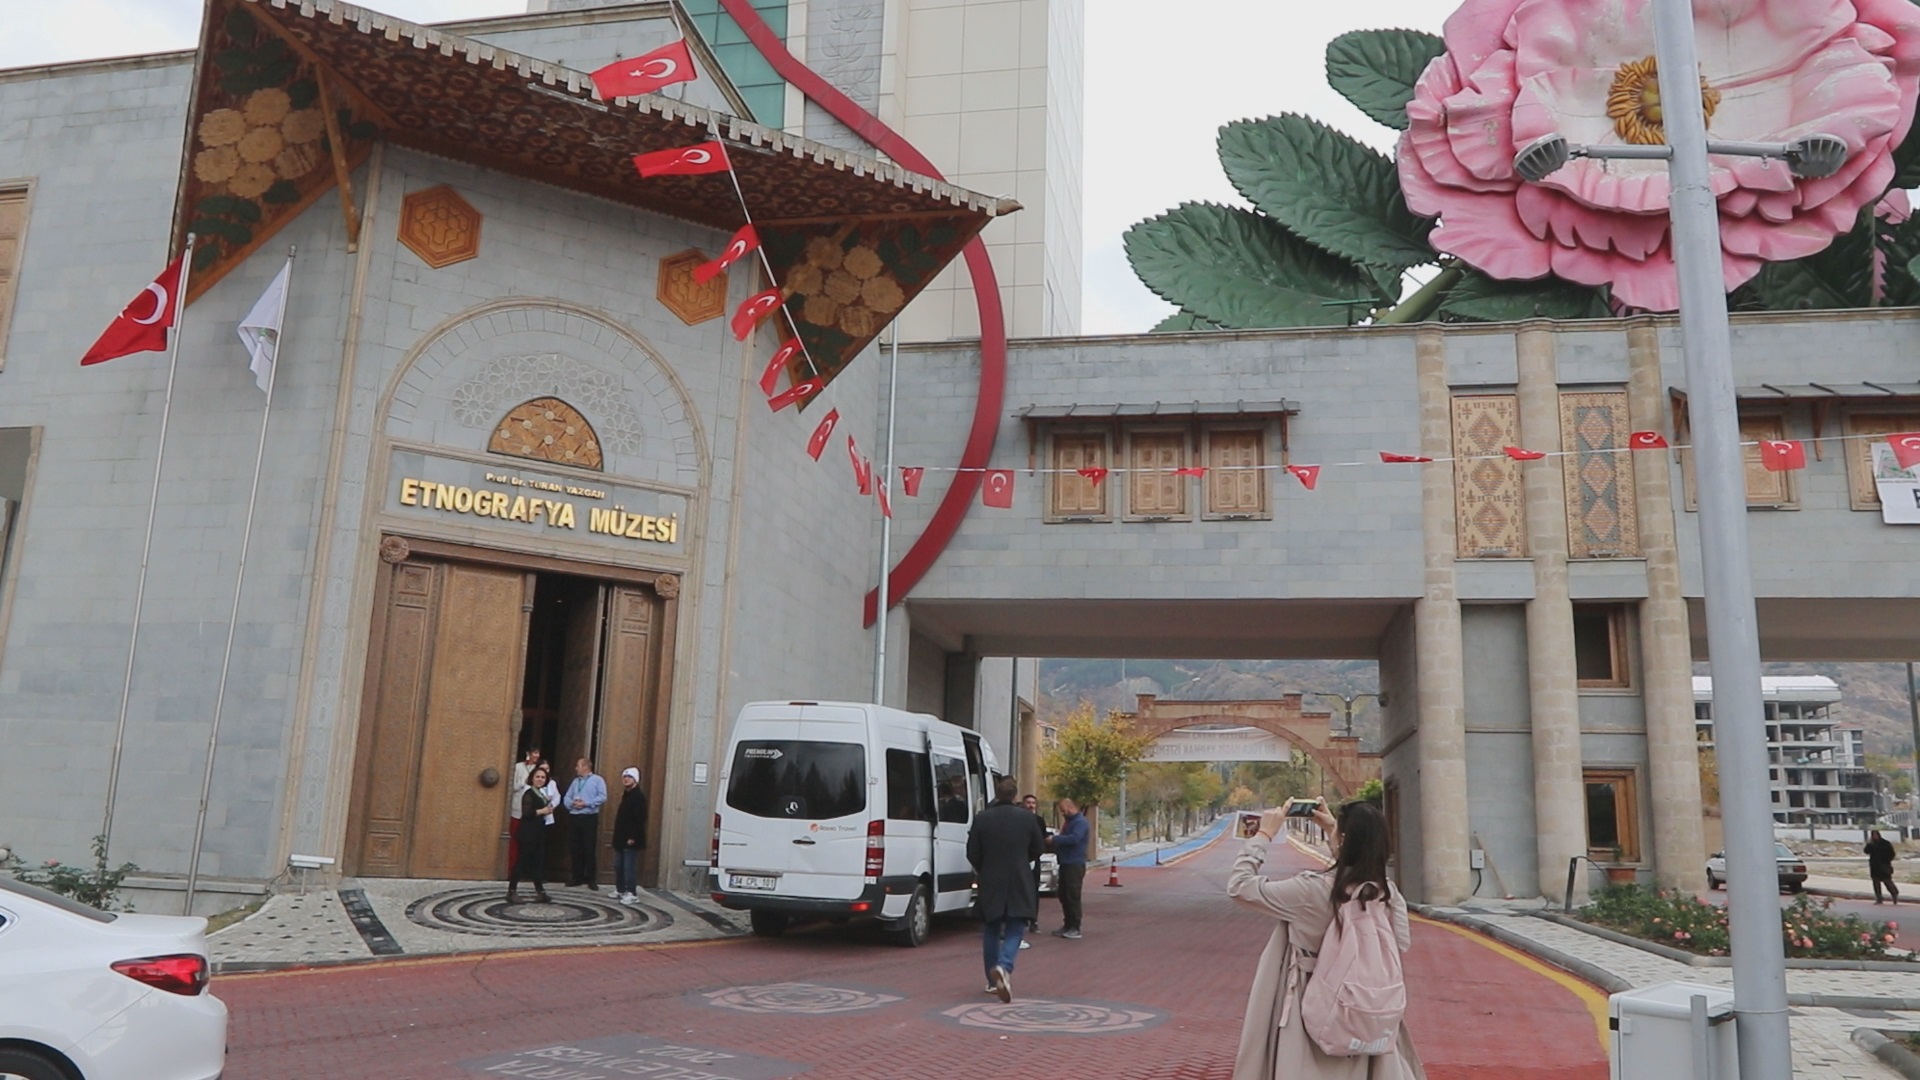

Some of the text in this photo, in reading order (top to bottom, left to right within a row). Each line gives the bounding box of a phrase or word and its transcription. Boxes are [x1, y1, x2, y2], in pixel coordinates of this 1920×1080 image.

[511, 476, 527, 487] Dr.
[529, 480, 562, 493] TURAN
[565, 485, 605, 499] YAZGAN
[400, 478, 678, 543] ETNOGRAFYA MÜZESİ
